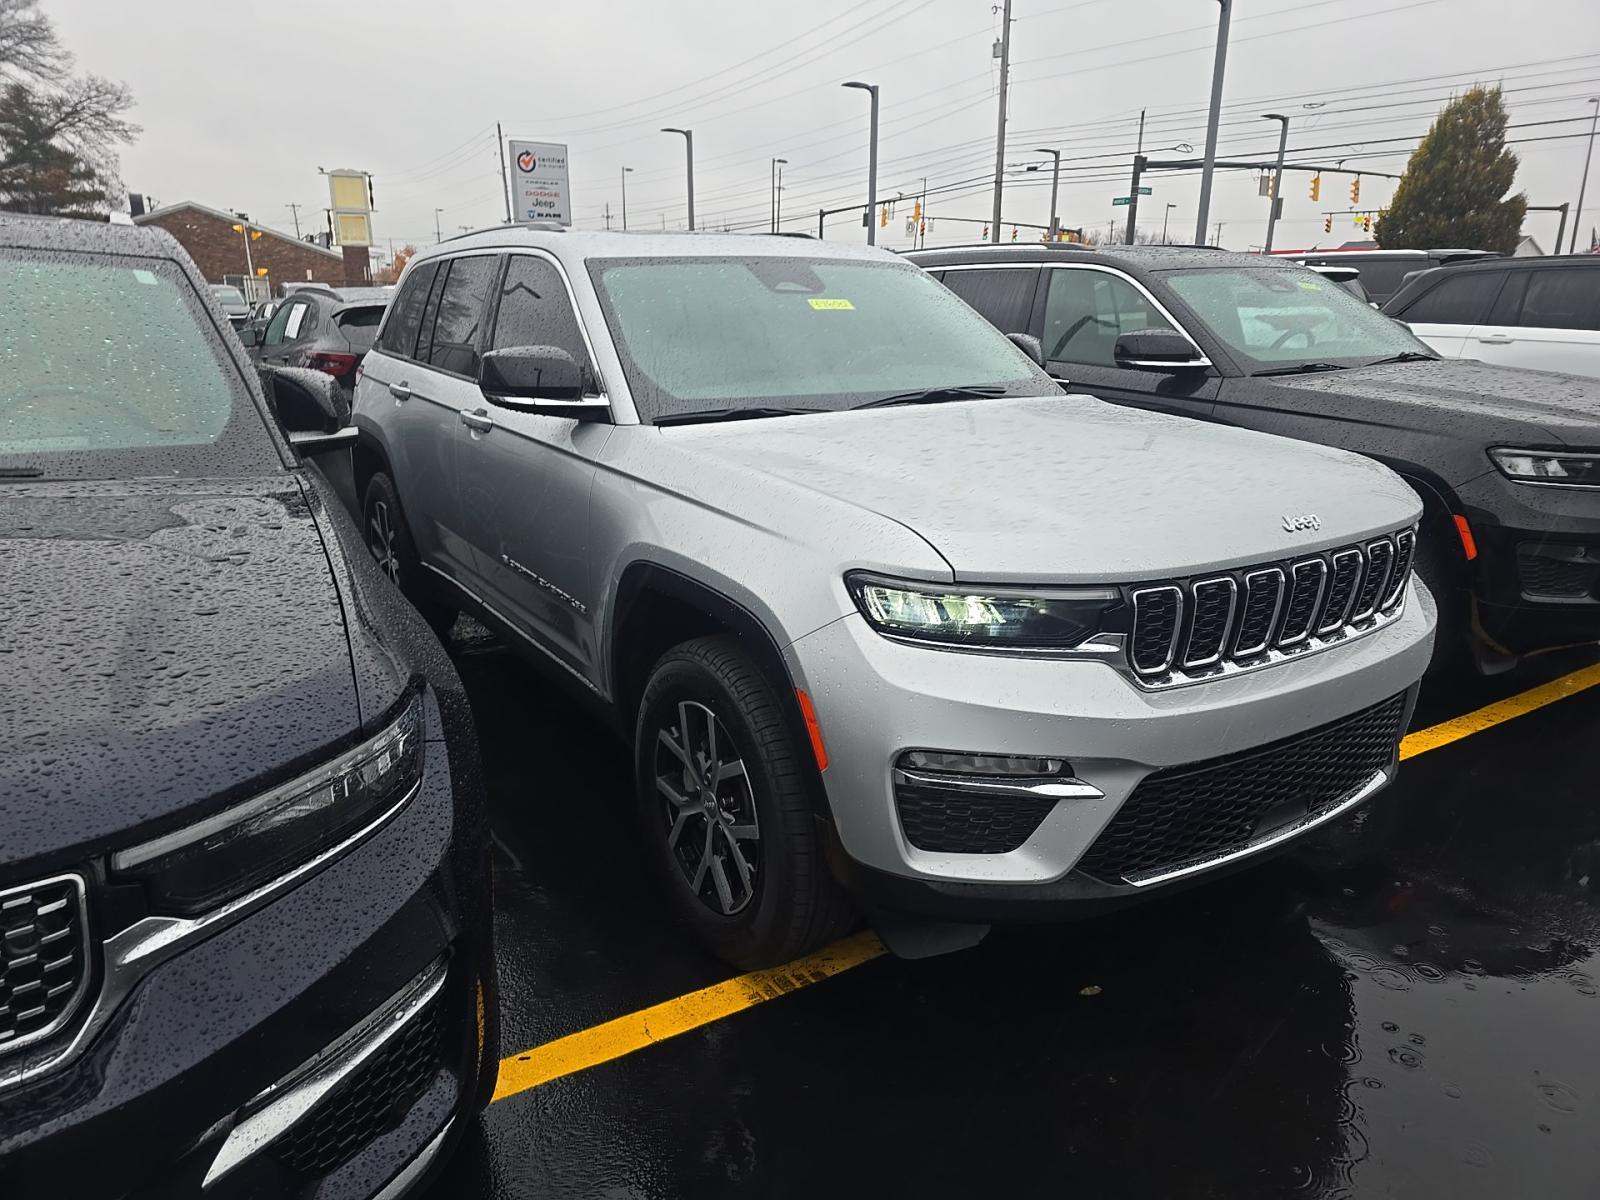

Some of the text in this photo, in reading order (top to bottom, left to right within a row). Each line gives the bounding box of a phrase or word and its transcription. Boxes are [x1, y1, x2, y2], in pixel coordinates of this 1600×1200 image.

[525, 190, 560, 198] DODGE
[532, 198, 555, 209] Jeep
[1281, 513, 1321, 533] Jeep
